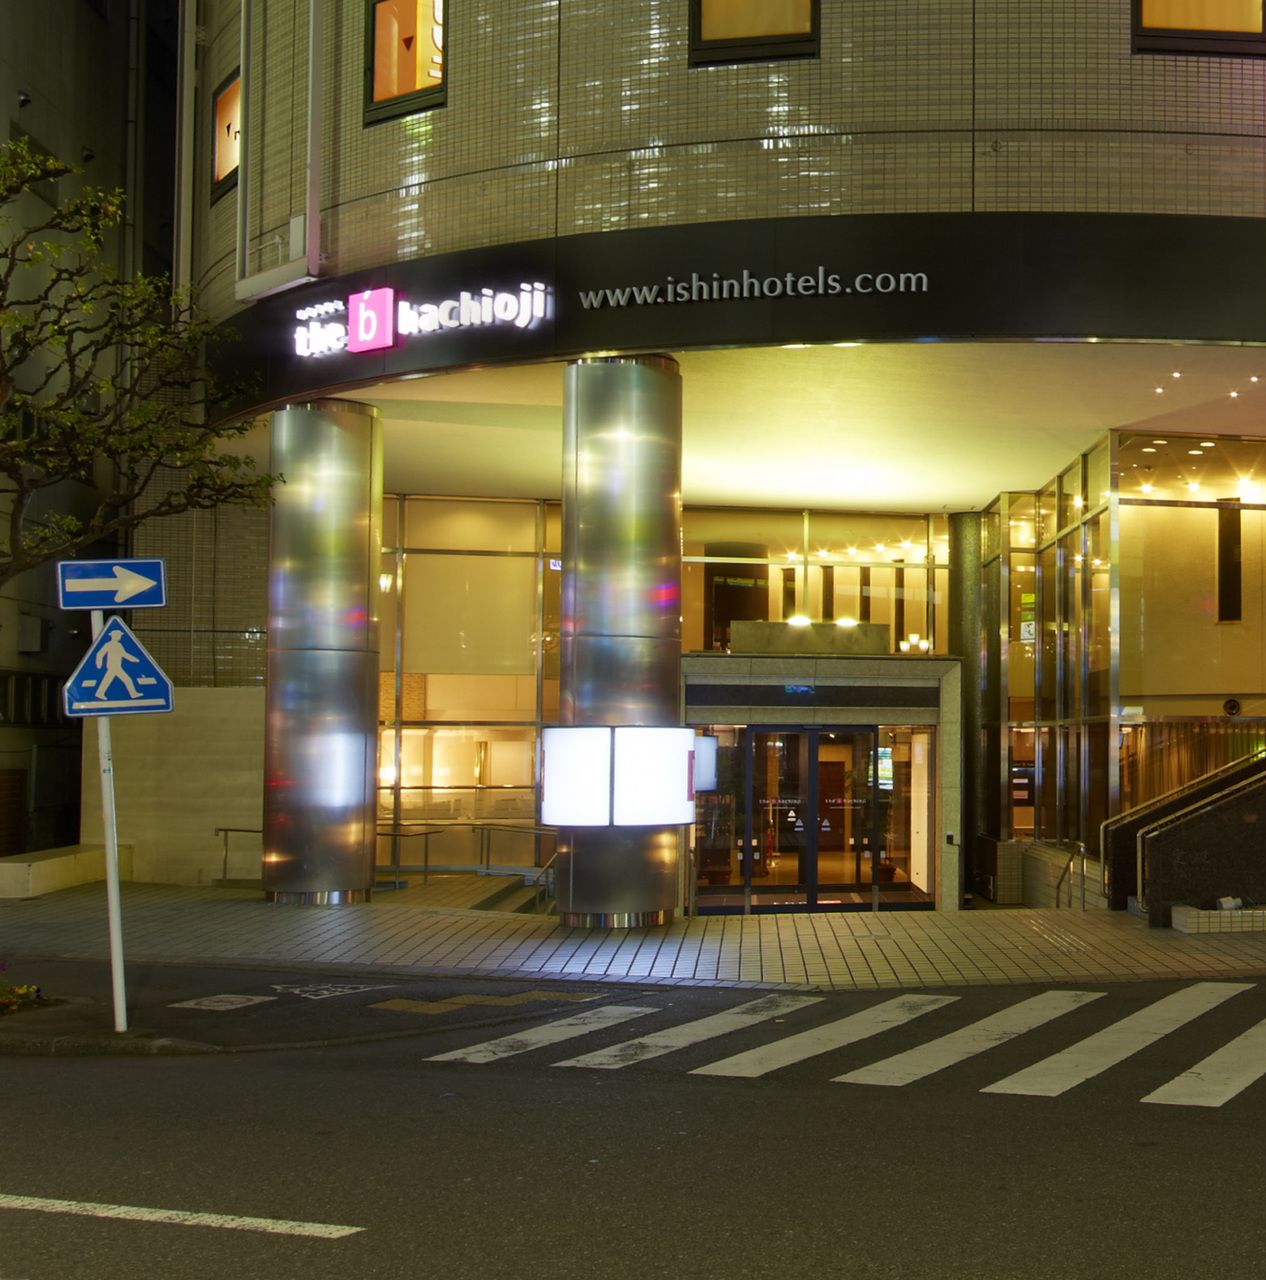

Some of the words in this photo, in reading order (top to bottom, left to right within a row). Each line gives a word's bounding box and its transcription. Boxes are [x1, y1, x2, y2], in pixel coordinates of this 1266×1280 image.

[579, 266, 928, 310] www.ishinhotels.com
[294, 322, 346, 357] the
[398, 282, 546, 334] hachioji
